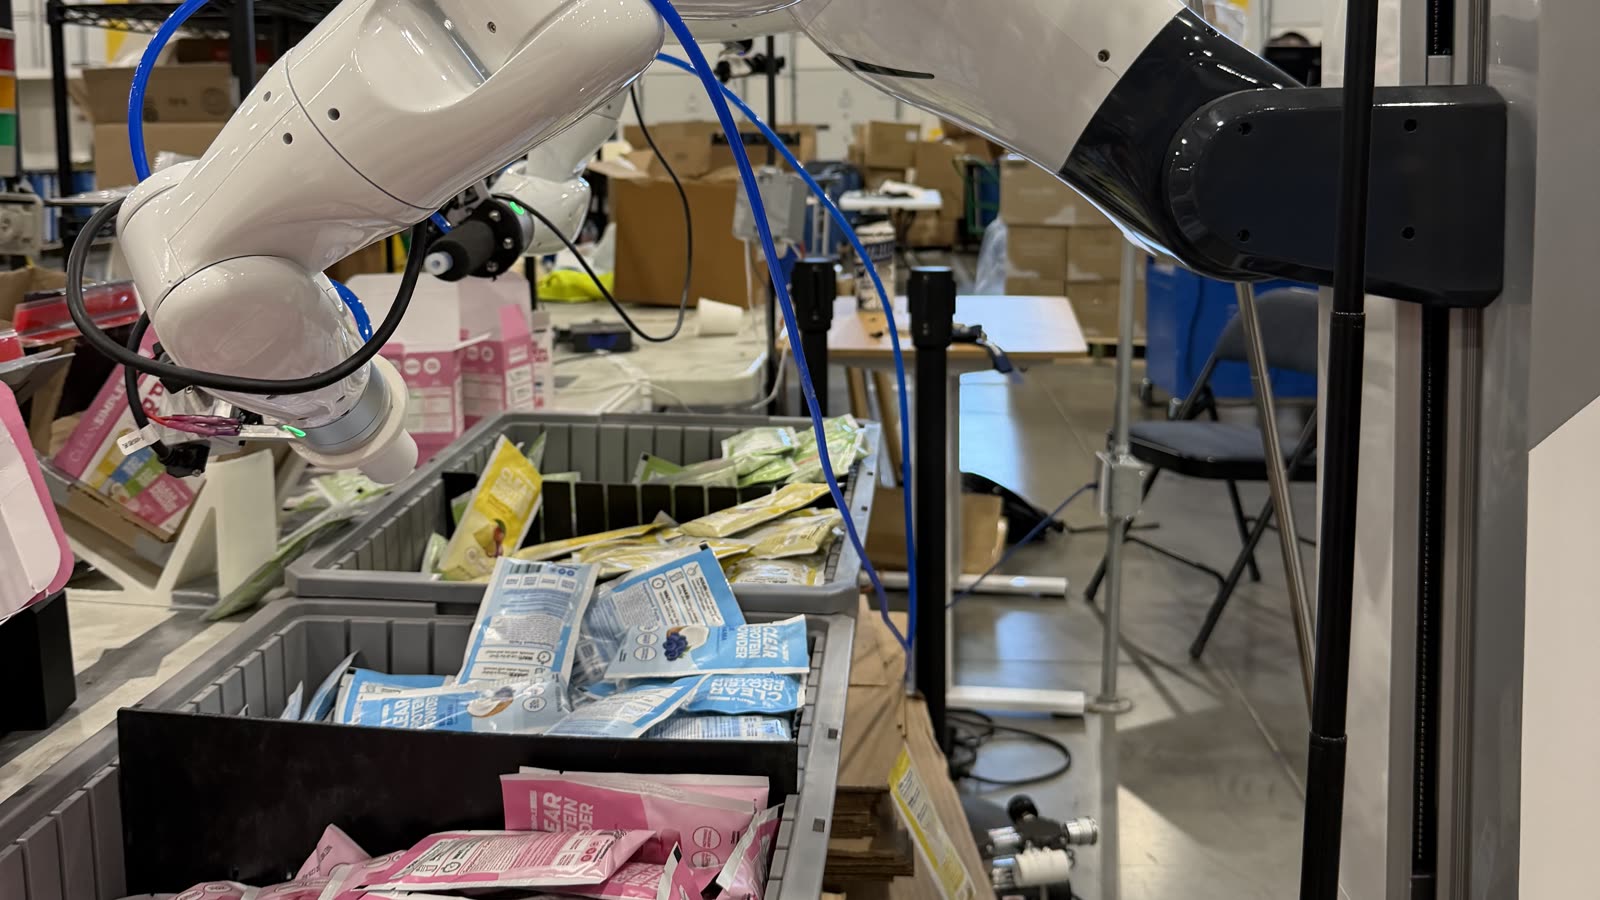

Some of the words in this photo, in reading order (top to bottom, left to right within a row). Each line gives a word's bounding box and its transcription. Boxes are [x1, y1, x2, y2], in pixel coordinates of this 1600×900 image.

[736, 625, 748, 658] OWDER
[762, 626, 778, 658] CLEAR
[393, 698, 411, 728] LEAR
[543, 792, 562, 832] EAR
[563, 796, 578, 832] TEIN
[579, 802, 593, 831] DER
